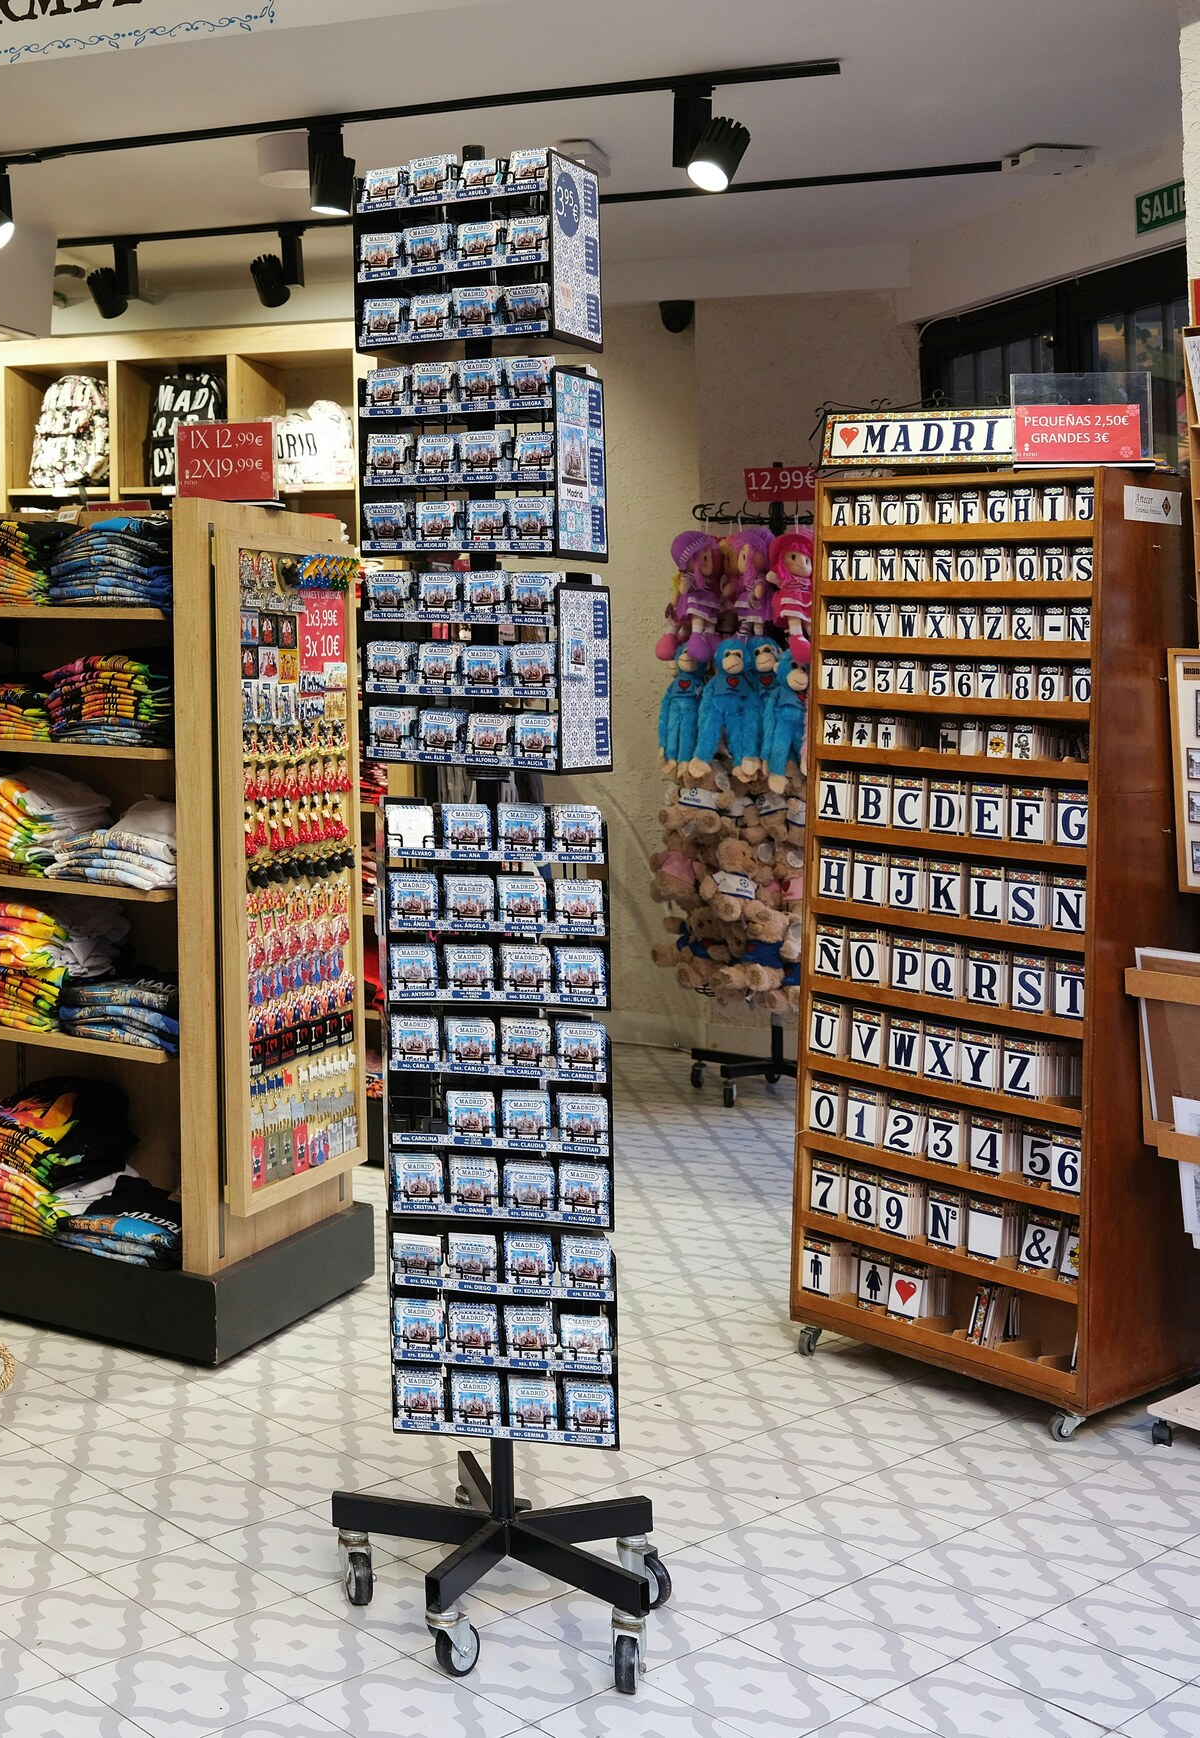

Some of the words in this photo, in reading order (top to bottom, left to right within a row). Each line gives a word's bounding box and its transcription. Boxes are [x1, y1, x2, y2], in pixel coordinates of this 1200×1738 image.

[1024, 414, 1091, 428] PEQUEÑAS
[1095, 416, 1129, 427] 2,50€
[862, 421, 1013, 453] MADRI
[1031, 433, 1090, 444] GRANDES
[1094, 433, 1109, 443] 3€
[747, 470, 815, 492] 12,99€
[566, 488, 584, 500] Madrid
[832, 506, 848, 526] A
[857, 503, 871, 526] B
[884, 503, 897, 525] C
[905, 503, 920, 524] D
[937, 502, 953, 524] E
[962, 501, 978, 523] F
[989, 500, 1005, 521] G
[1014, 497, 1030, 521] H
[1079, 497, 1093, 520] J
[832, 559, 846, 580] K
[853, 559, 868, 580] L
[878, 558, 895, 580] M
[904, 559, 919, 580] N
[936, 557, 952, 581] Ñ
[984, 559, 1000, 581] P
[1022, 559, 1035, 582] Q
[1046, 558, 1062, 581] R
[1076, 557, 1092, 581] S
[305, 610, 338, 629] 1x3,99€
[305, 635, 317, 657] 3x
[321, 635, 340, 657] 10€
[820, 784, 840, 816] A
[861, 787, 881, 820] B
[898, 792, 919, 824] C
[933, 795, 955, 828] D
[975, 799, 998, 833] E
[1016, 802, 1040, 836] F
[1062, 806, 1088, 841] G
[411, 849, 432, 857] ÁLVARO
[823, 861, 846, 894] H
[895, 872, 915, 904] J
[932, 876, 956, 910] K
[974, 880, 998, 916] L
[1012, 887, 1036, 921] S
[1056, 892, 1082, 928] N
[818, 939, 840, 972] Ñ
[897, 951, 918, 984] P
[931, 958, 953, 992] Q
[973, 963, 996, 1000] R
[1018, 970, 1042, 1006] S
[1061, 976, 1084, 1014] T
[889, 1115, 913, 1148] 2
[933, 1123, 952, 1158] 3
[976, 1133, 999, 1168] 4
[1029, 1140, 1051, 1175] 5
[1058, 1151, 1079, 1187] 6
[815, 1175, 834, 1208] 7
[854, 1185, 872, 1218] 8
[886, 1196, 902, 1229] 9
[1025, 1228, 1051, 1264] &
